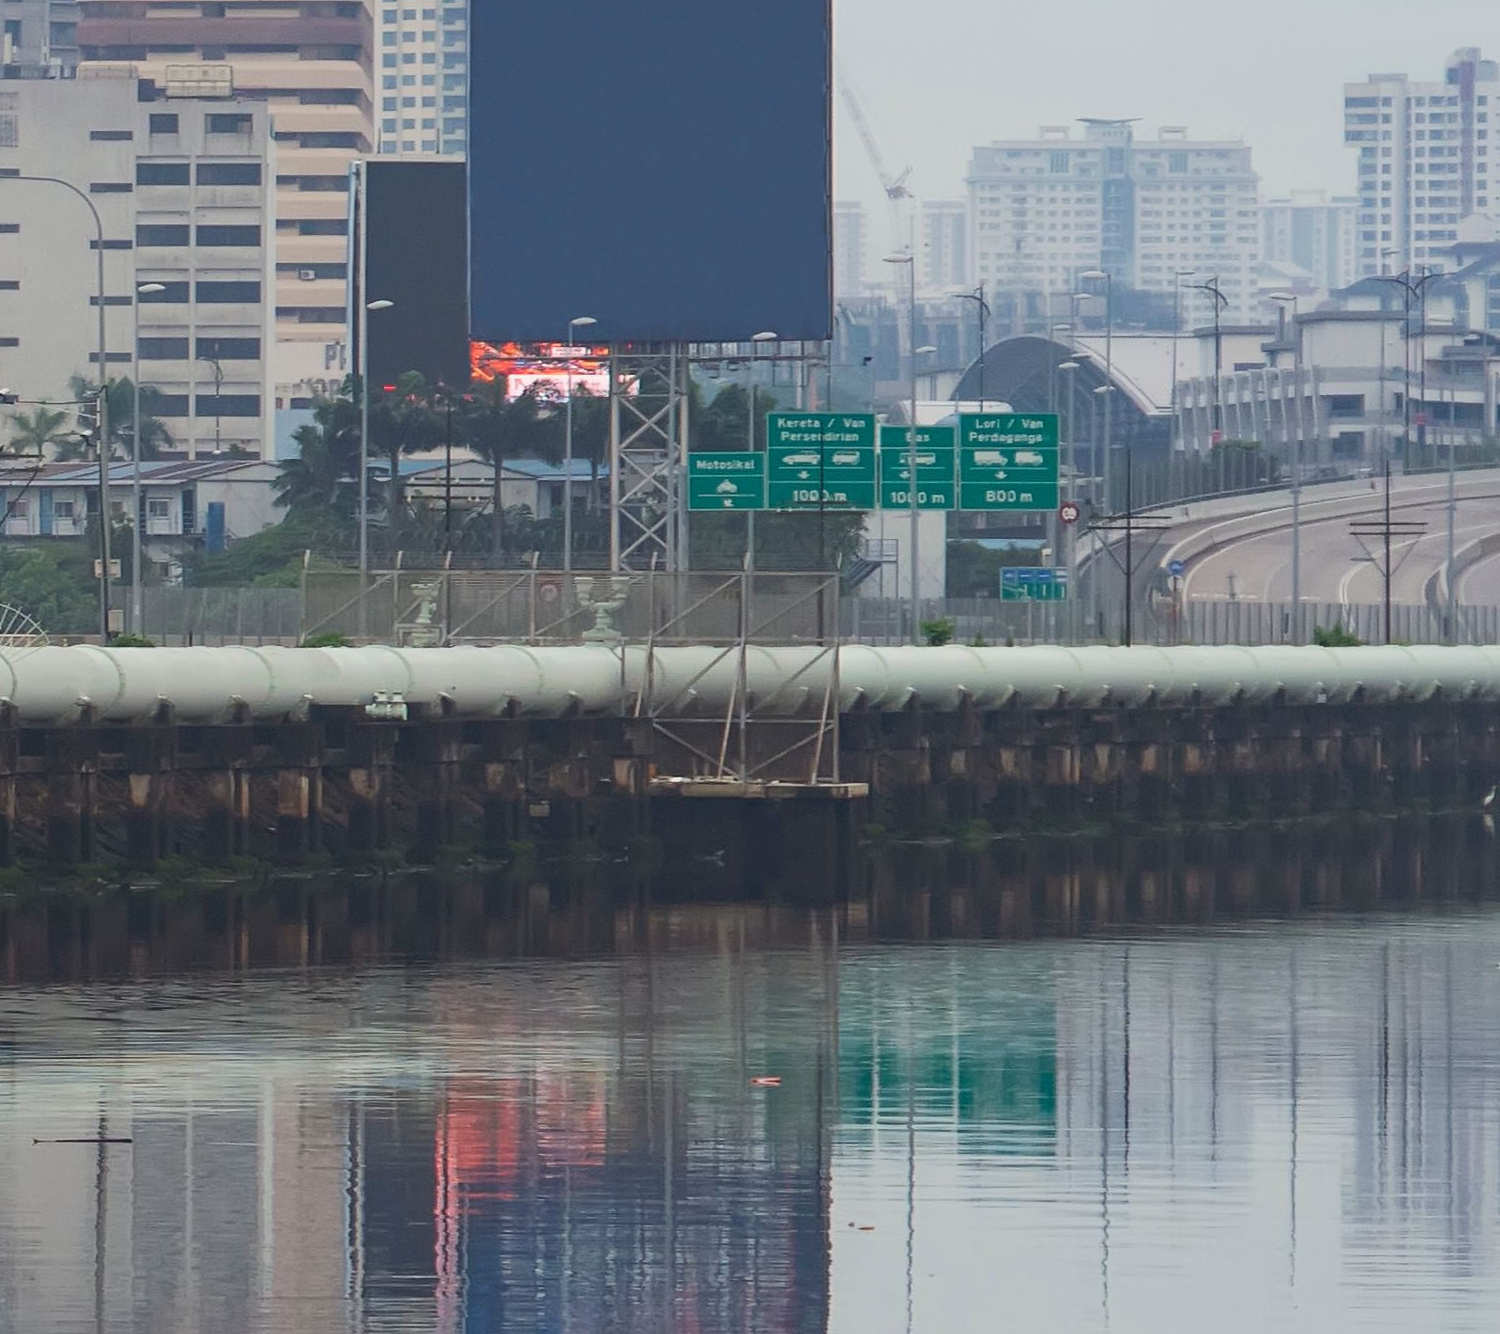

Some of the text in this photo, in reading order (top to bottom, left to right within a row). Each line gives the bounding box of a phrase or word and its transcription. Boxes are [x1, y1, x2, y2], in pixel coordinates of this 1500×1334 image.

[777, 418, 820, 428] Kereta
[843, 418, 865, 428] Van
[1021, 419, 1044, 429] Van
[781, 431, 859, 442] Persendirian
[696, 460, 755, 470] Motosikal
[931, 494, 945, 503] m
[1020, 493, 1033, 502] m
